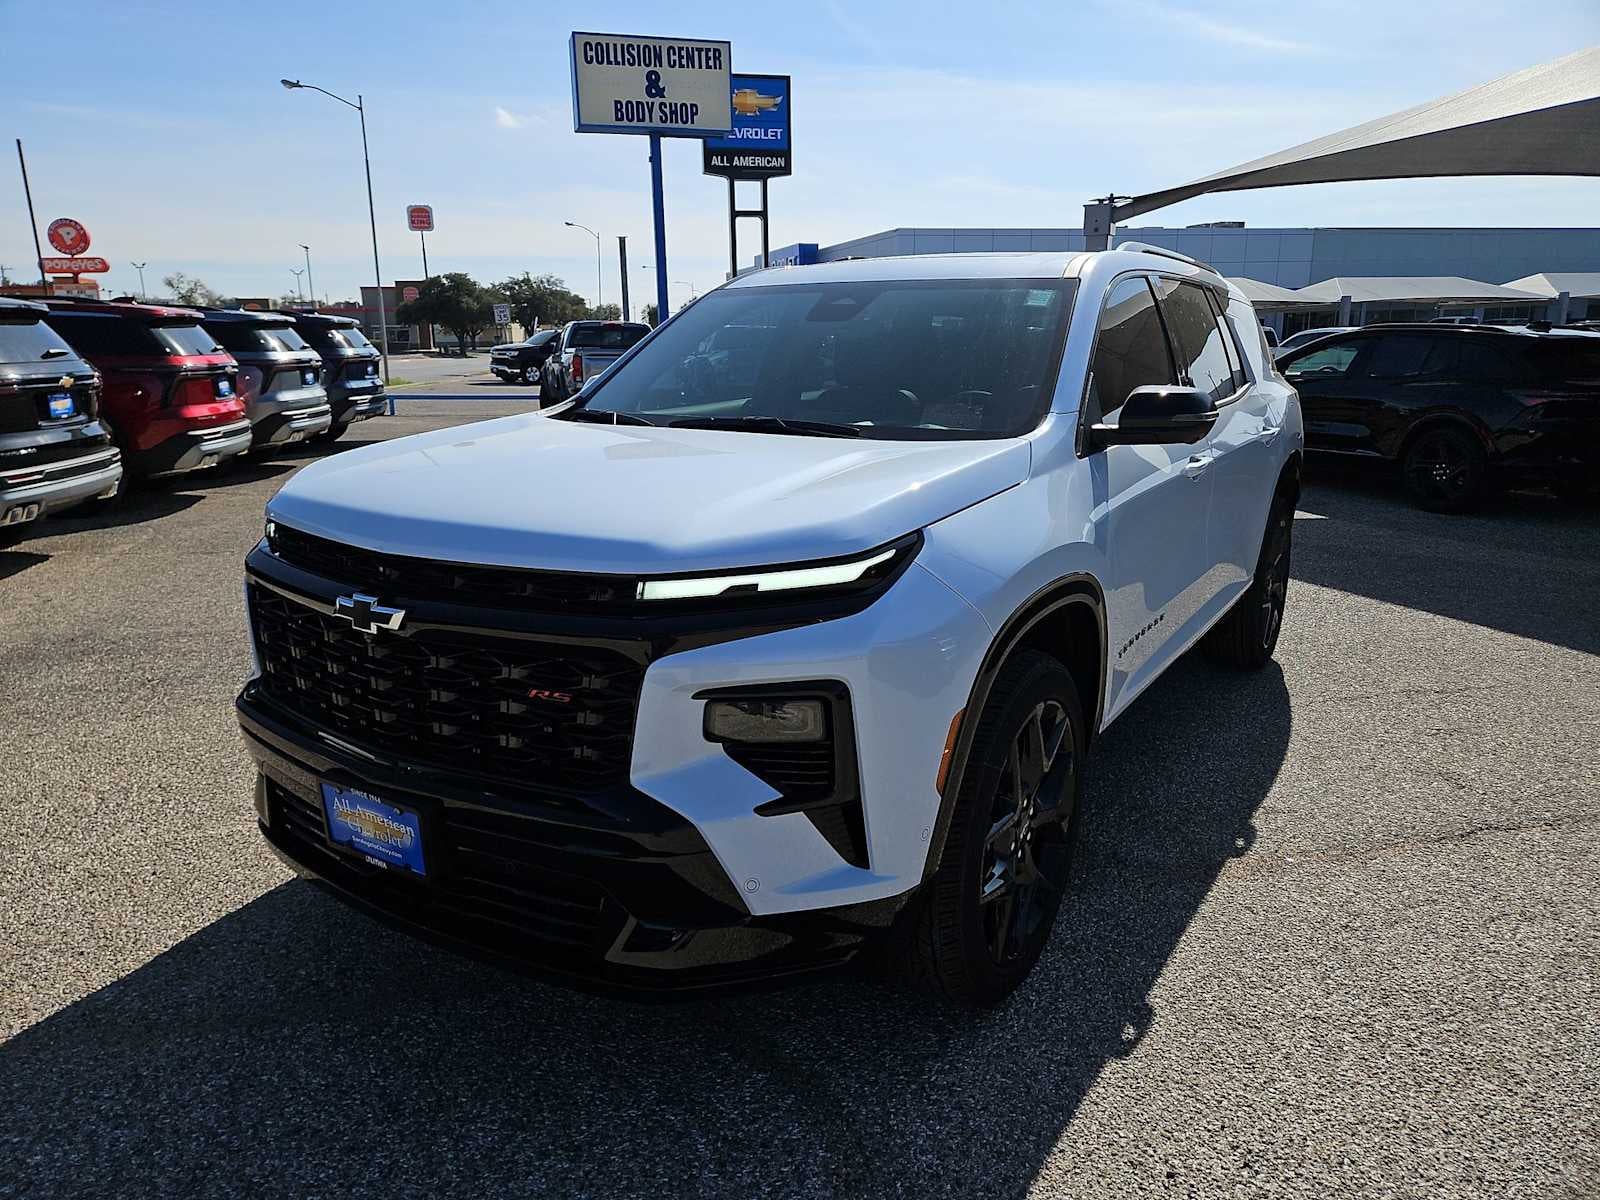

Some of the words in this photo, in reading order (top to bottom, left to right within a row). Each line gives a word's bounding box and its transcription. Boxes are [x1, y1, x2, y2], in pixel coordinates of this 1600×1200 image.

[583, 41, 663, 68] COLLISION
[667, 45, 722, 70] CENTER
[645, 70, 666, 98] &
[614, 100, 656, 123] BODY
[658, 102, 699, 125] SHOP
[727, 127, 783, 140] EVROLET
[711, 155, 730, 166] ALL
[733, 156, 785, 167] AMERICAN
[528, 689, 573, 703] RS
[333, 797, 351, 814] All
[355, 804, 415, 837] American
